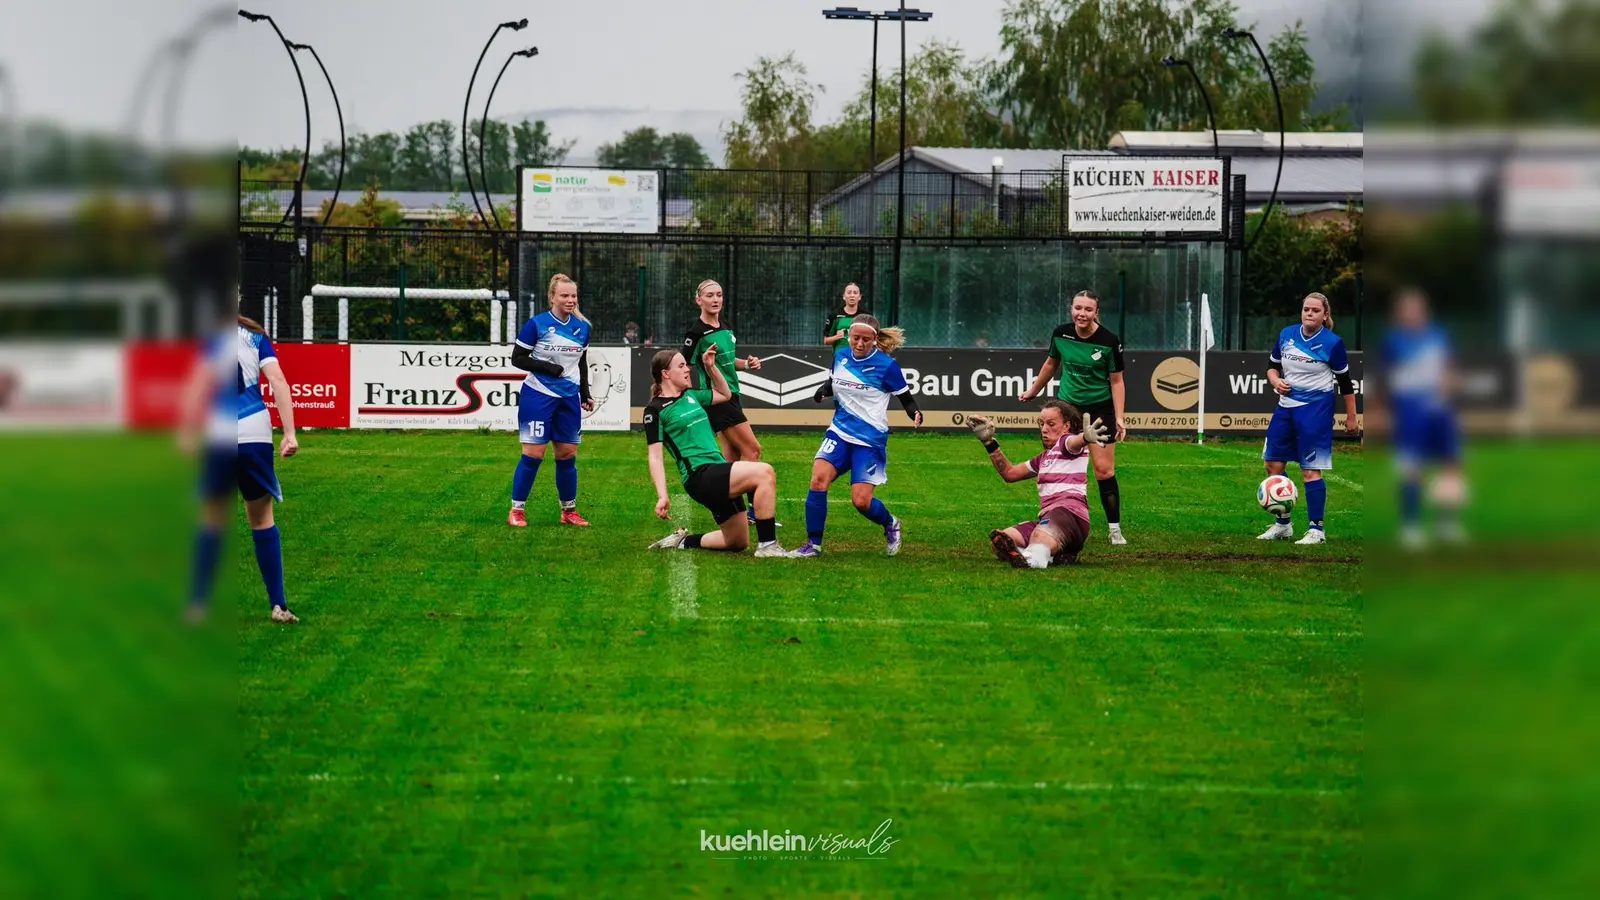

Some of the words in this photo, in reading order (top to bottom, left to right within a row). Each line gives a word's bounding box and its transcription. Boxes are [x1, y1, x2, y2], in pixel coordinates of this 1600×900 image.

[555, 176, 588, 185] natur
[1073, 167, 1145, 186] KÜCHEN
[1153, 170, 1219, 186] KAISER
[1075, 206, 1216, 222] www.kuechenkaiser-weiden.de
[399, 350, 512, 372] Metzger
[901, 368, 960, 397] Bau
[1229, 374, 1268, 395] Wir
[364, 382, 457, 406] Franz
[291, 401, 335, 409] ohenstrauß
[528, 420, 545, 438] 15
[997, 416, 1029, 425] Weiden
[1123, 417, 1141, 426] 961
[1151, 417, 1168, 426] 470
[1171, 417, 1188, 426] 270
[1234, 417, 1270, 427] info@fb
[819, 437, 838, 454] 16
